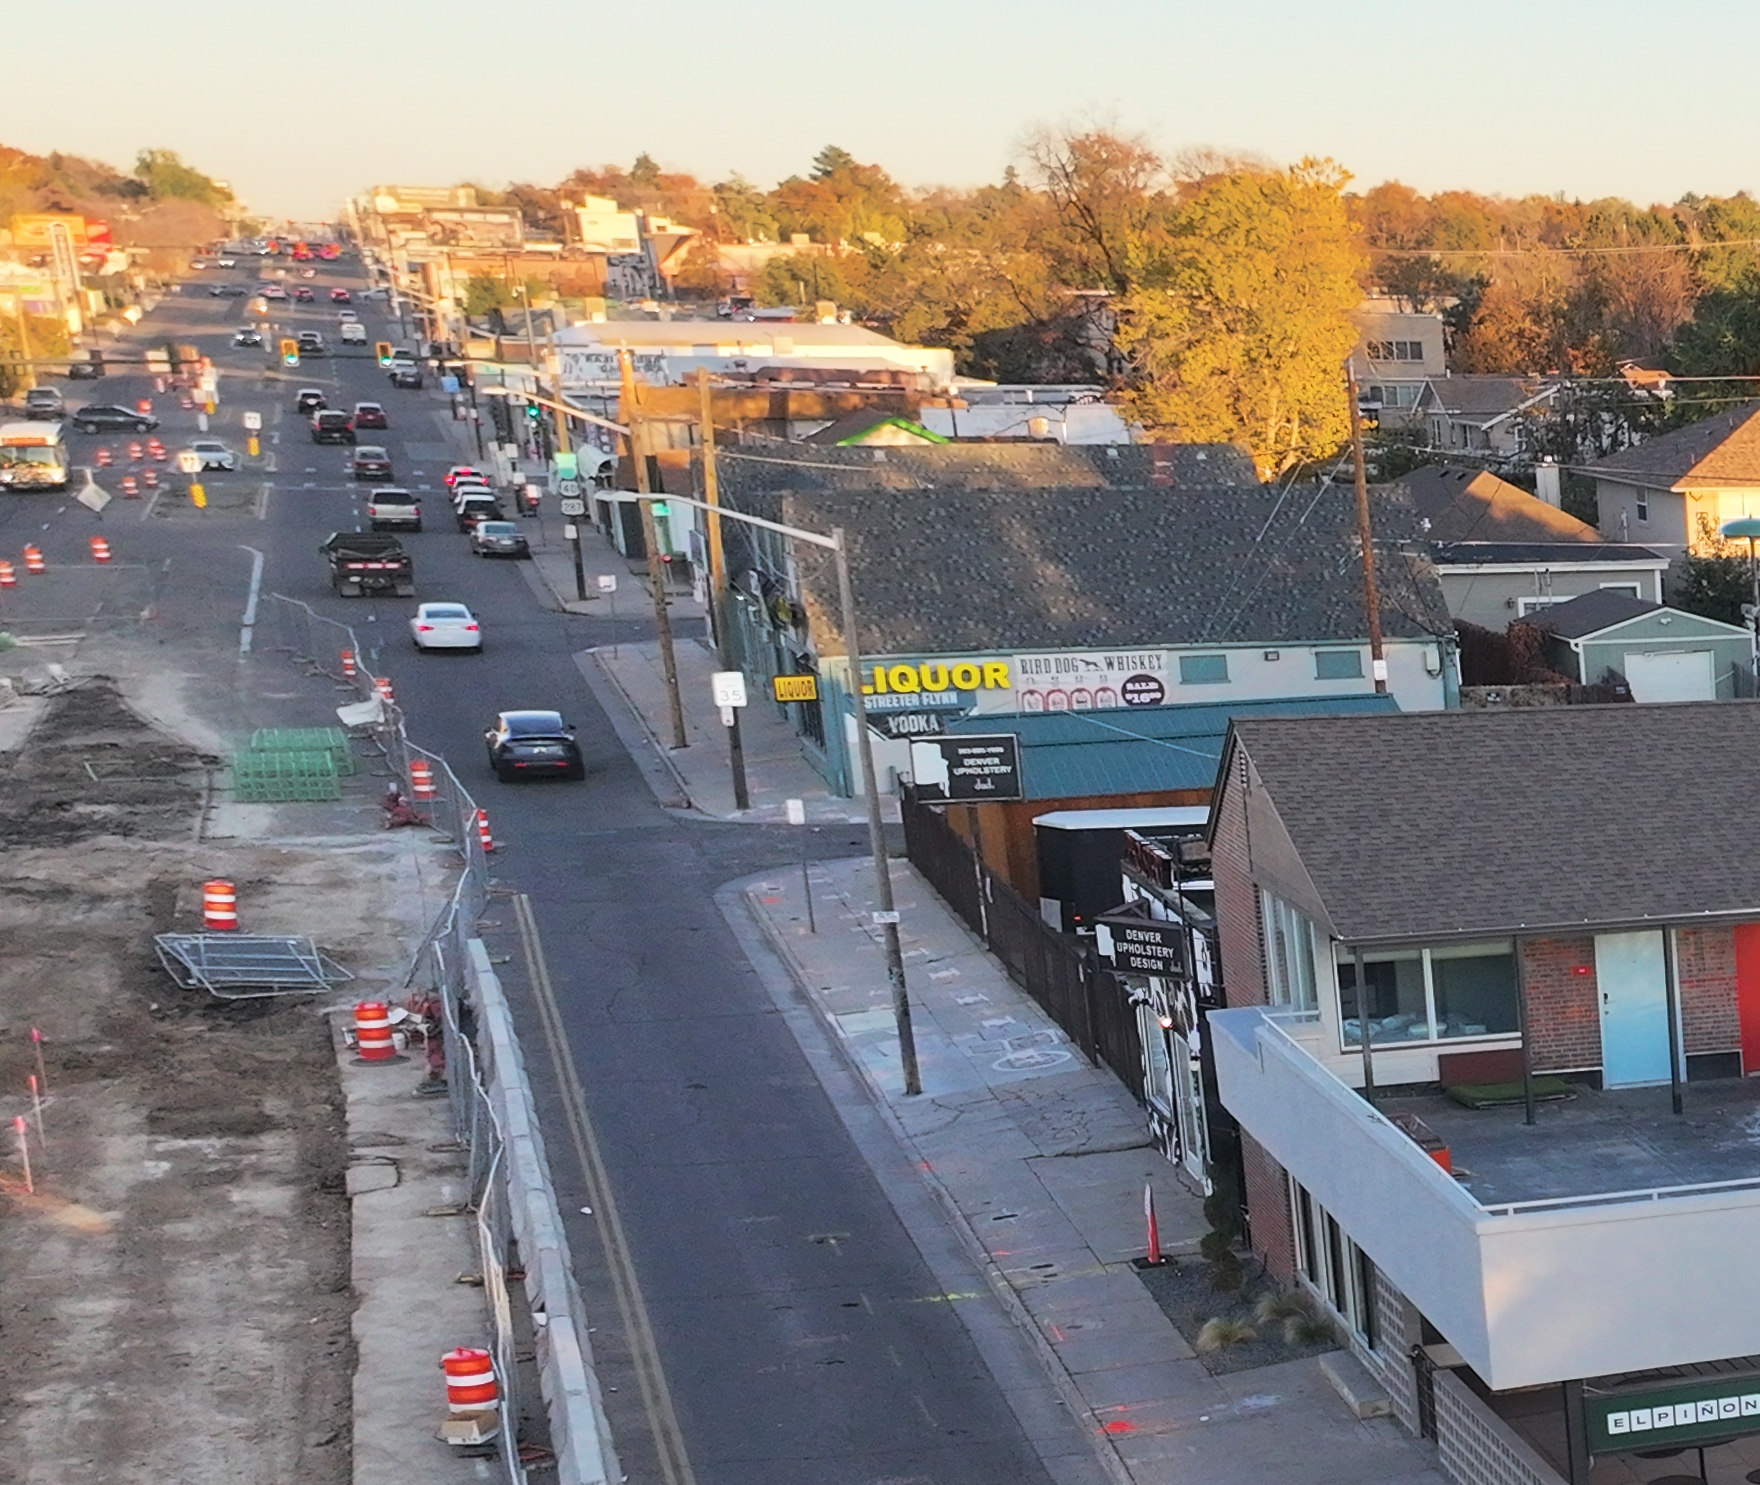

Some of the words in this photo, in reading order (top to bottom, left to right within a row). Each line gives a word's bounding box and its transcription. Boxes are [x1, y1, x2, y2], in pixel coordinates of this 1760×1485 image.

[564, 502, 581, 512] 287
[1021, 659, 1052, 674] BIRD
[1055, 657, 1079, 674] DOG
[1104, 654, 1162, 671] WHISKEY
[720, 690, 742, 701] 35
[778, 680, 815, 698] LIQUOR
[888, 714, 940, 733] VODKA
[963, 757, 1000, 766] DENVER
[953, 766, 1012, 776] UPHOLSTERY
[1126, 929, 1162, 943] DENVER
[1116, 942, 1174, 958] UPHOLSTERY
[1130, 957, 1164, 971] DESIGN
